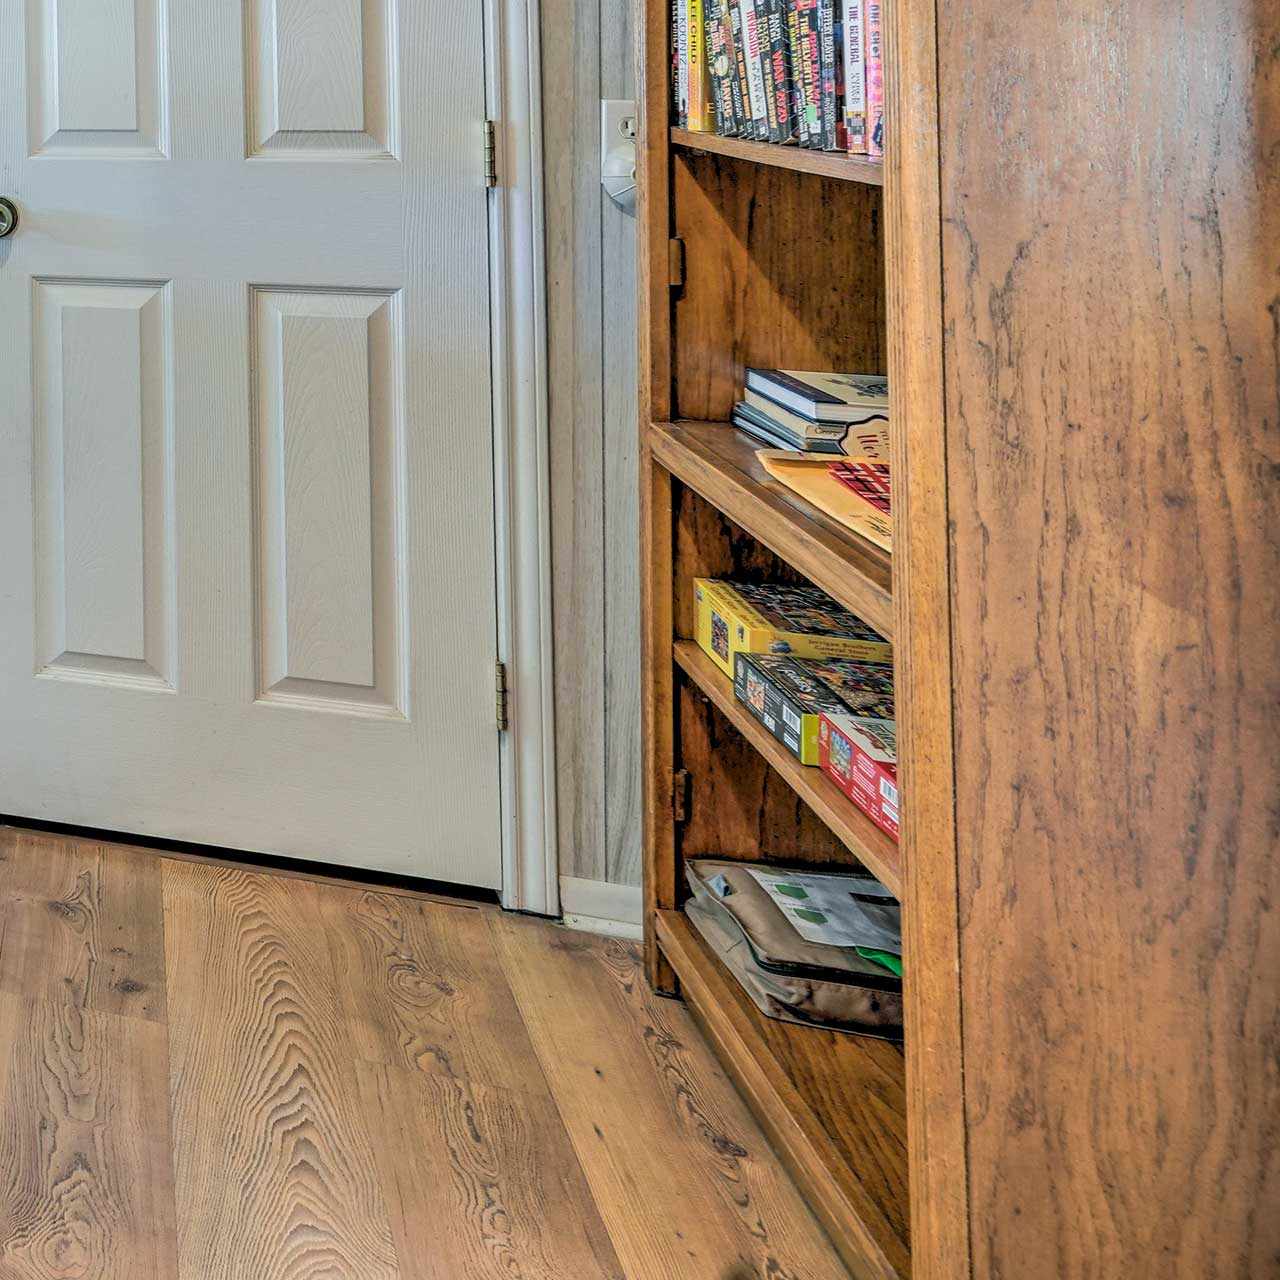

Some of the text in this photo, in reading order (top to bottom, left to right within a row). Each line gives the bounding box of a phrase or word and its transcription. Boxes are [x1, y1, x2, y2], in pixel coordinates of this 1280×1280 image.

[747, 10, 759, 59] INVASION
[800, 16, 809, 36] THE
[848, 6, 858, 65] THE GENERAL
[870, 5, 879, 26] ONE
[721, 79, 733, 117] HAVOC
[772, 48, 788, 123] WAR 2020
